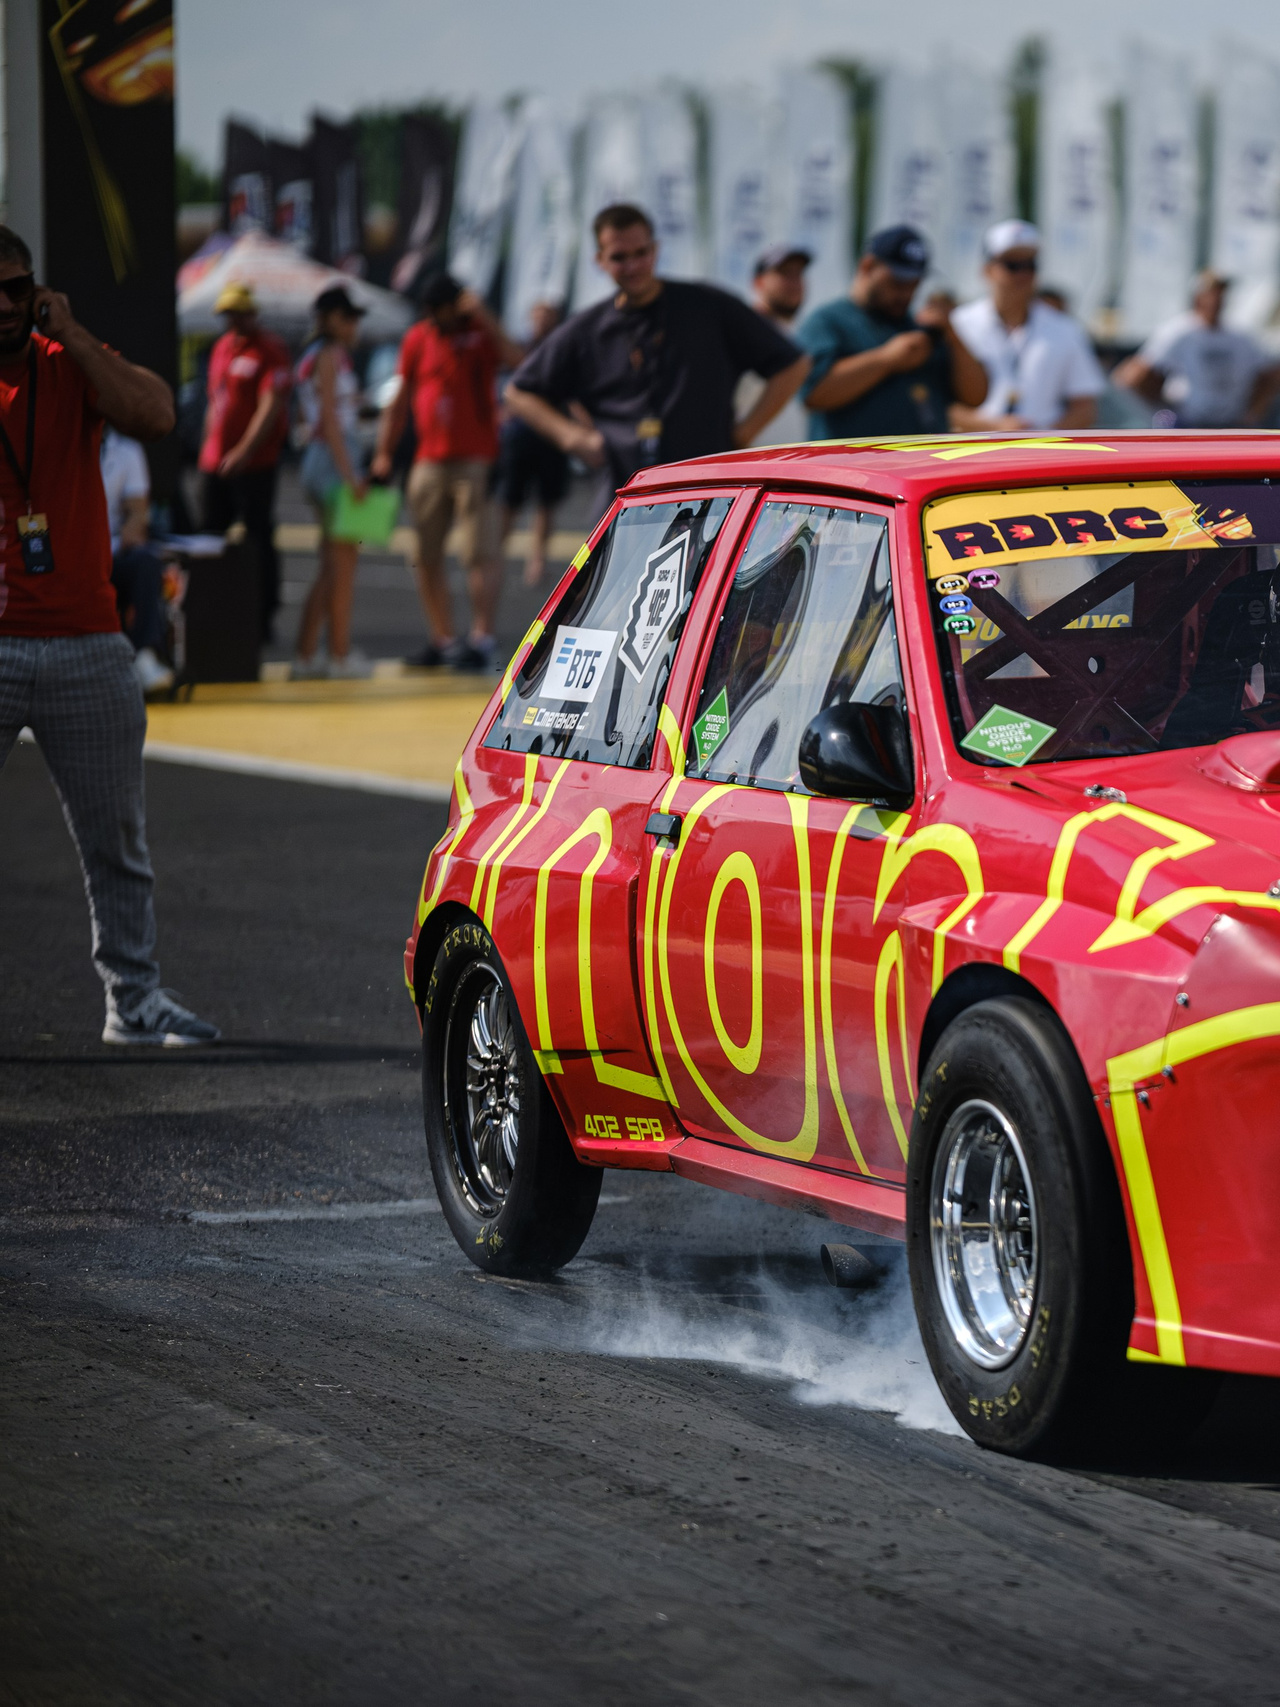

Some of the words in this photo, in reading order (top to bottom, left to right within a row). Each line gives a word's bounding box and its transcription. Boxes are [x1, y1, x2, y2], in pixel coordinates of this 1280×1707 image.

[933, 507, 1169, 560] RDRC
[646, 589, 671, 627] 402
[563, 648, 603, 690] ВТБ
[704, 714, 726, 724] NITROUS
[705, 722, 721, 733] OXIDE
[979, 721, 1031, 736] NITROUS
[989, 728, 1026, 740] OXIDE
[701, 731, 720, 741] SYSTEM
[987, 734, 1033, 748] SYSTEM
[443, 923, 492, 958] FRONT
[584, 1114, 622, 1139] 402
[624, 1116, 665, 1142] SPB
